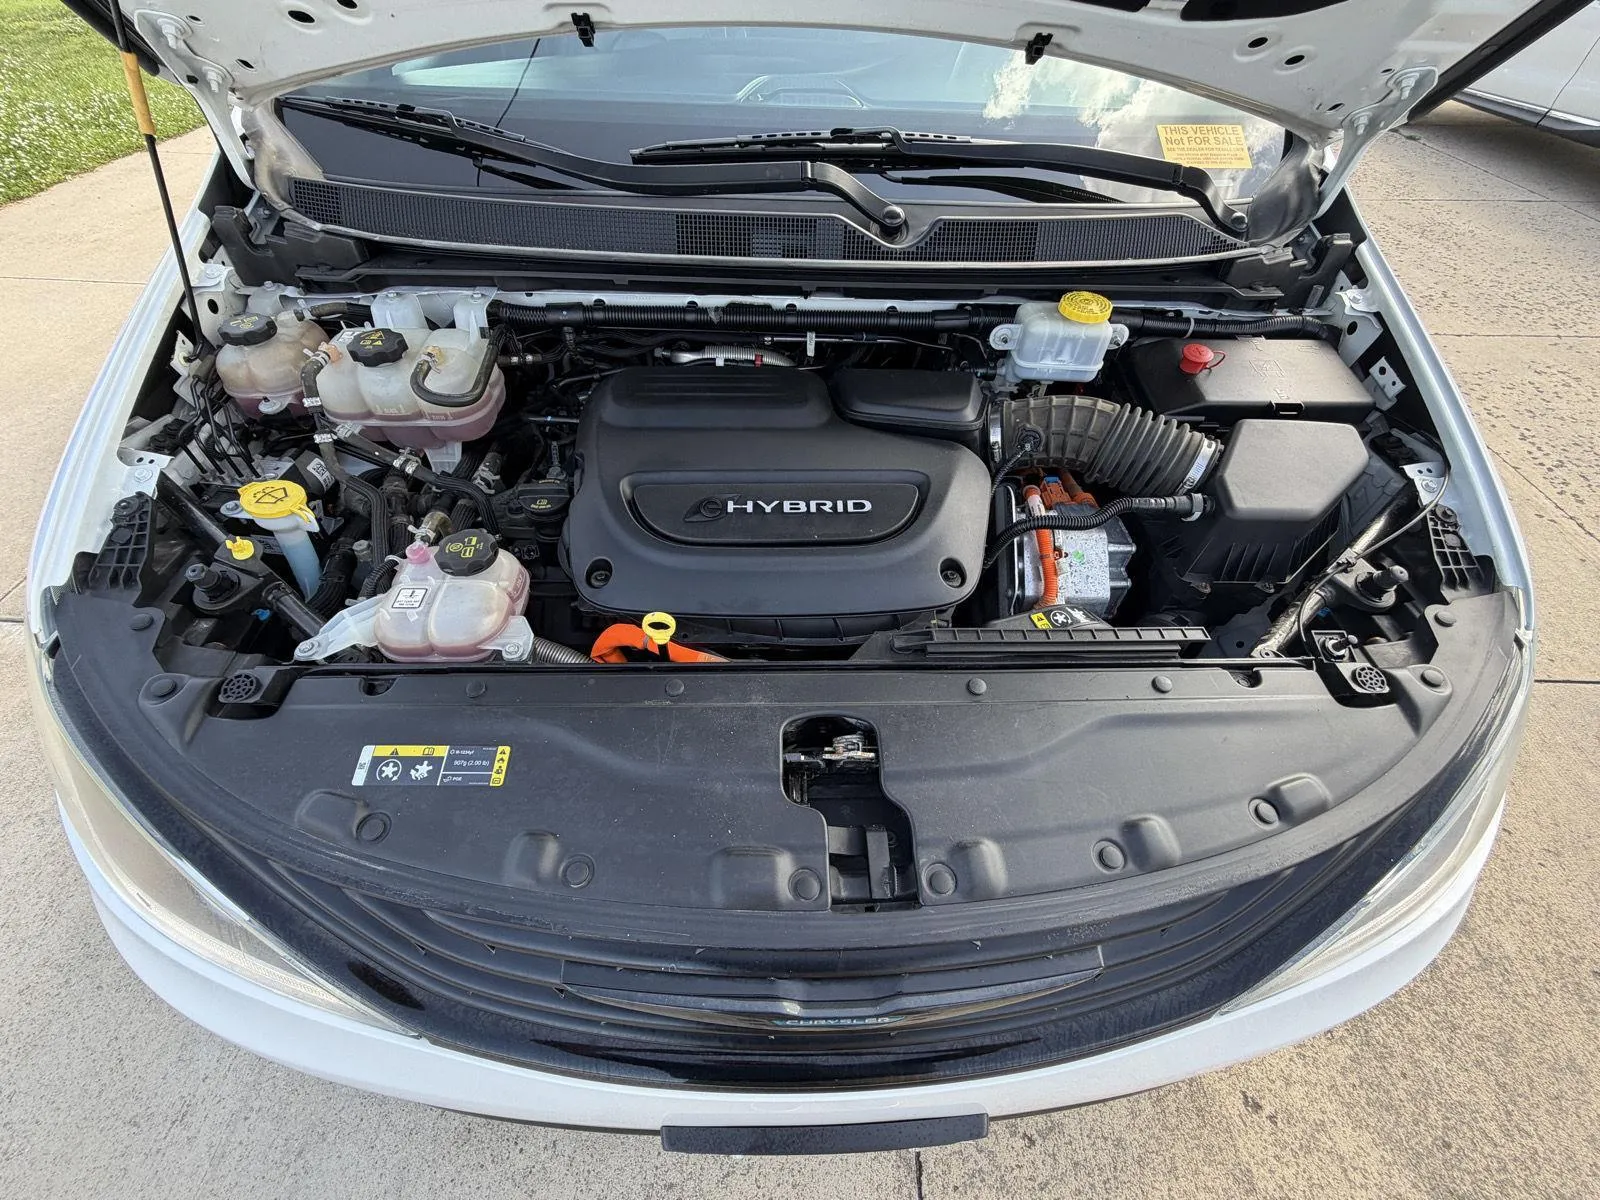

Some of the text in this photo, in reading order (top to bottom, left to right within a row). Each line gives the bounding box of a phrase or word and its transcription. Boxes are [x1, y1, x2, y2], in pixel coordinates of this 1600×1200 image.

[1162, 126, 1240, 135] THIS VEHICLE
[1165, 136, 1244, 146] Not FOR SALE
[727, 500, 873, 513] HYBRID
[785, 1017, 890, 1026] CHRYSLER
